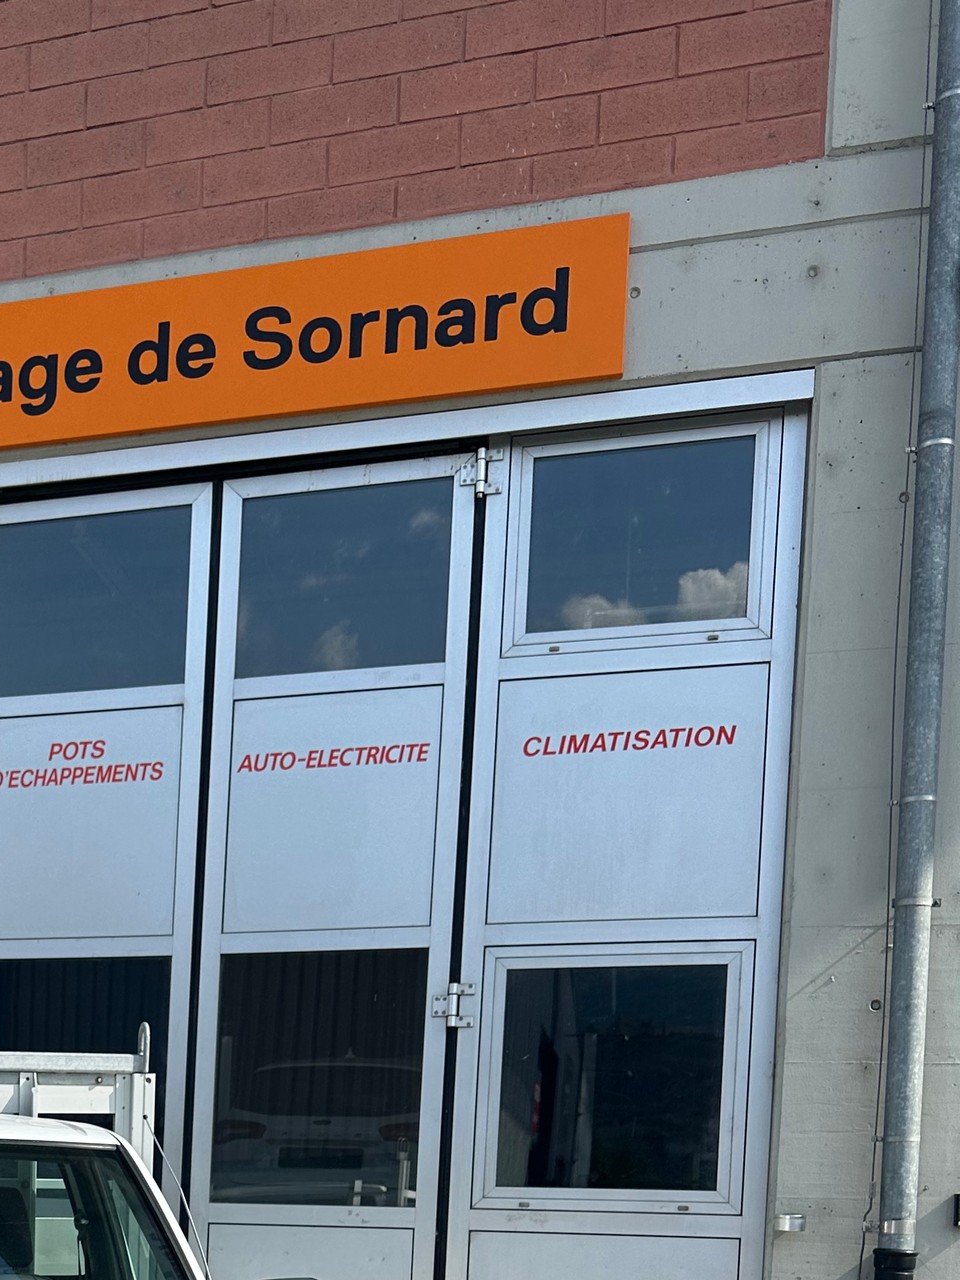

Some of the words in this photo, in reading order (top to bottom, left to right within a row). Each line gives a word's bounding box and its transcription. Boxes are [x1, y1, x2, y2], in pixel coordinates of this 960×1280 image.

[127, 320, 217, 386] de
[242, 266, 571, 371] Sornard
[48, 740, 106, 761] POTS
[523, 726, 737, 757] CLIMATISATION
[238, 742, 429, 773] AUTO-ELECTRICITE
